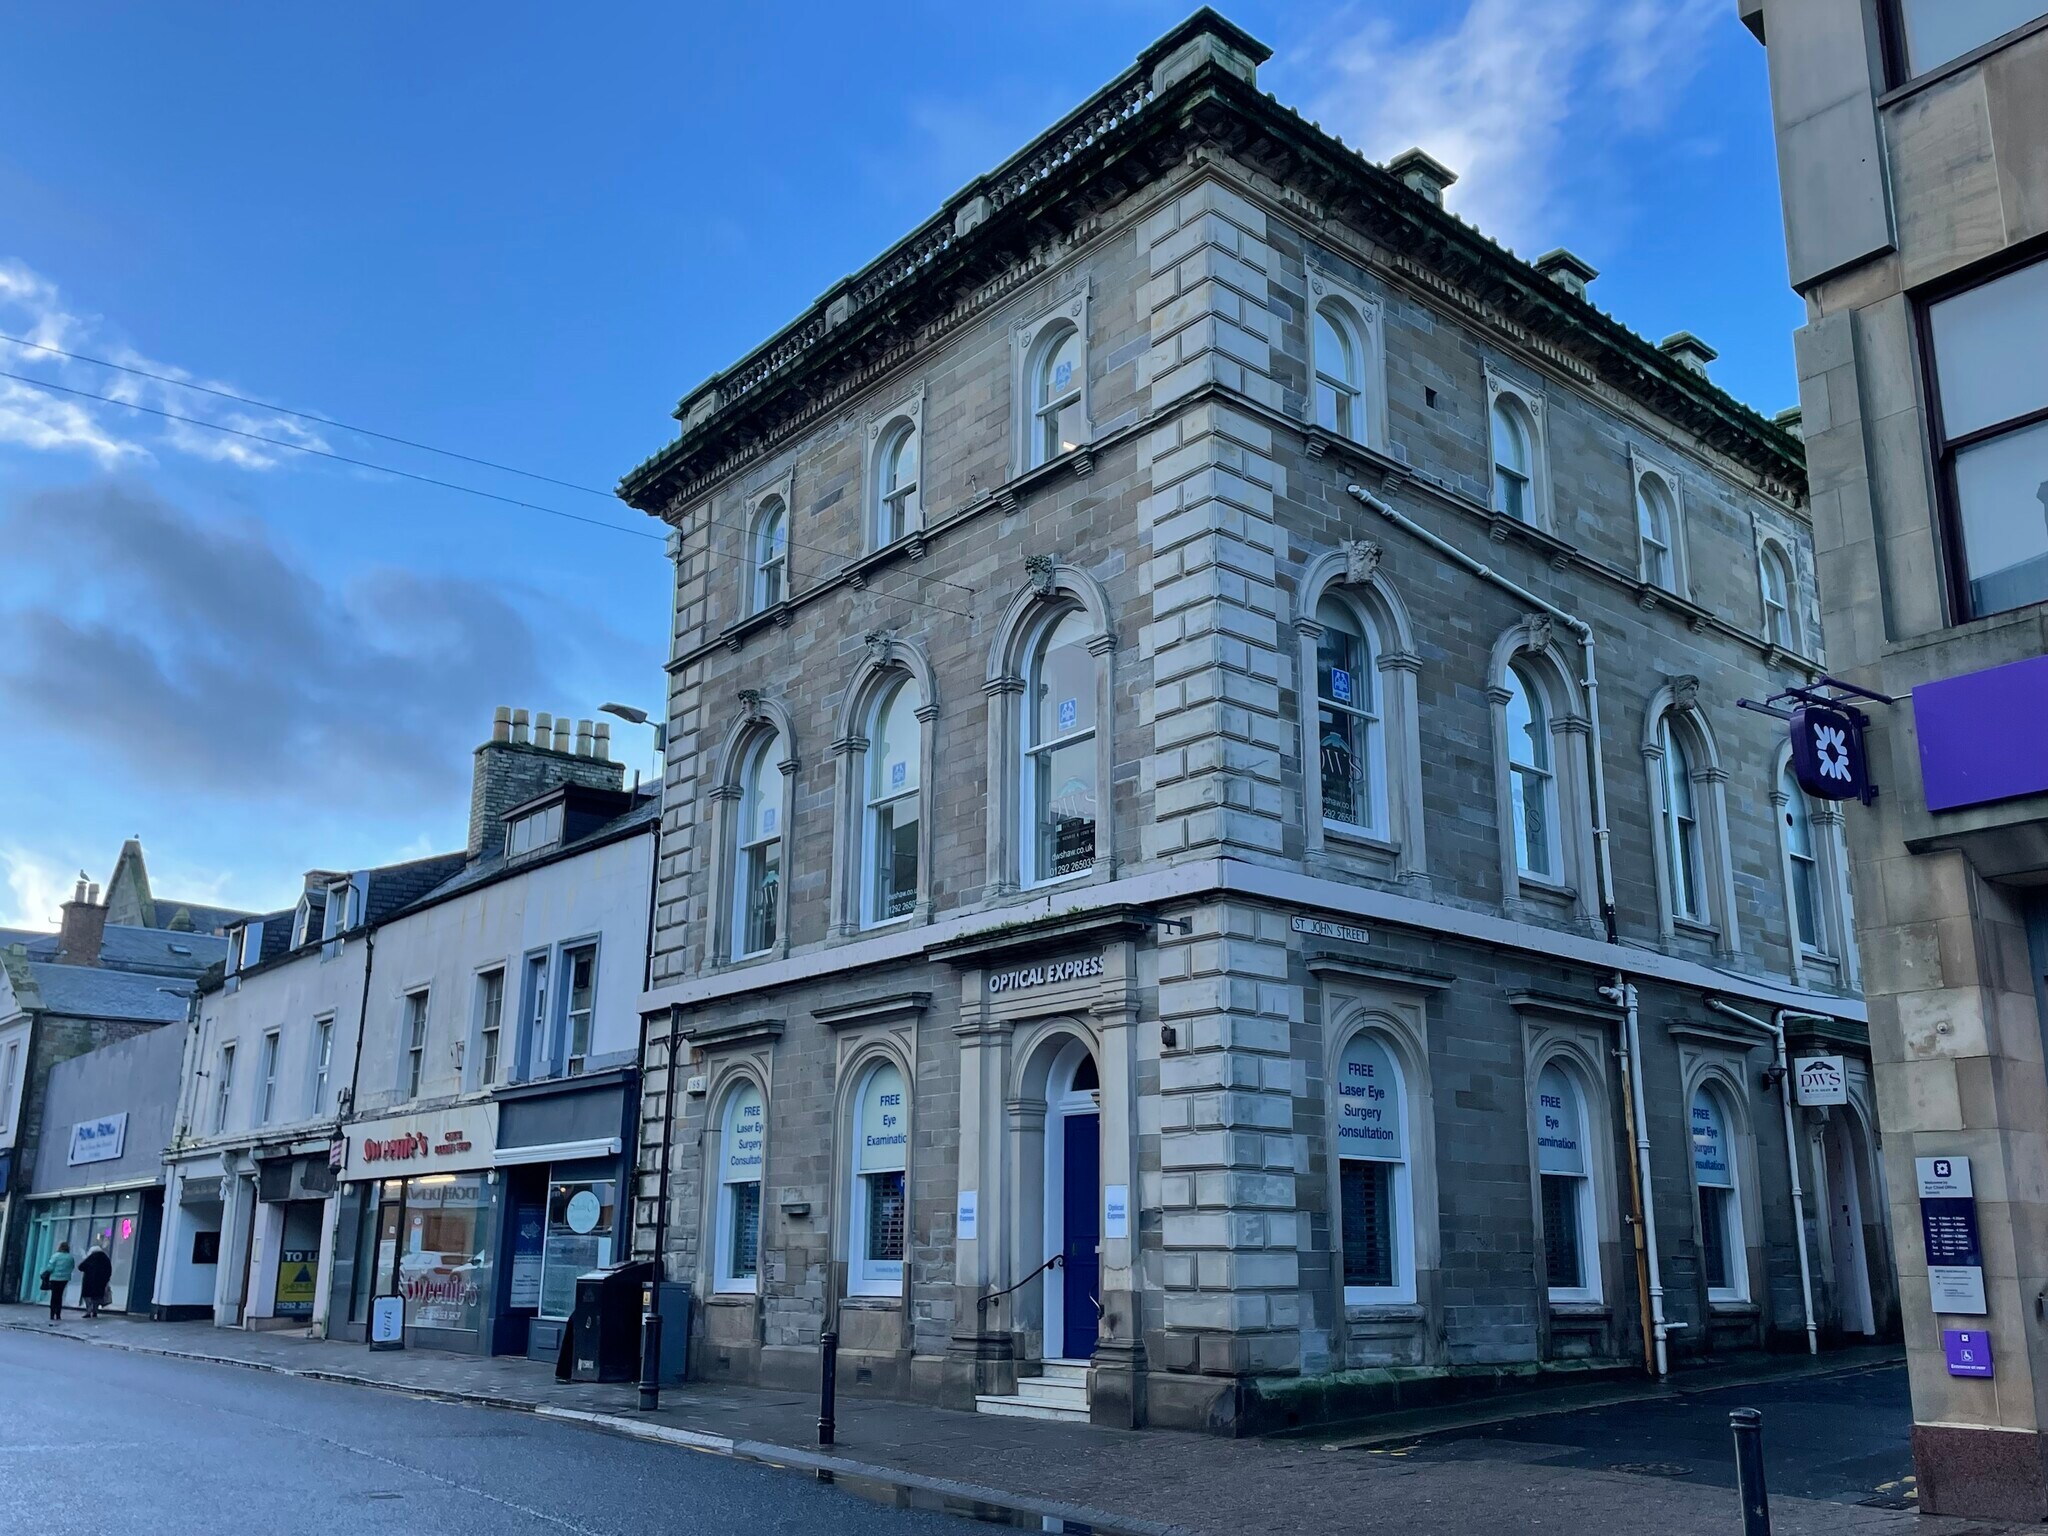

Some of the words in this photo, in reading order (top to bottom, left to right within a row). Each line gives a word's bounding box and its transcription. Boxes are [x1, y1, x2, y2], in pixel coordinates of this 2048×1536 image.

[1051, 843, 1094, 862] dwshaw.co.uk
[1050, 863, 1070, 877] 01292
[1295, 918, 1305, 930] ST
[1310, 920, 1333, 935] JOHN
[1337, 925, 1366, 941] STREET
[988, 966, 1044, 992] OPTICAL
[1047, 955, 1104, 982] EXPRESS
[1348, 1062, 1374, 1078] FREE
[1800, 1072, 1841, 1087] DWS
[1338, 1082, 1366, 1097] Laser
[1368, 1084, 1385, 1101] Eye
[880, 1093, 900, 1107] FREE
[1540, 1094, 1561, 1109] FREE
[744, 1106, 760, 1117] FREE
[1344, 1103, 1382, 1122] Surgery
[1692, 1107, 1710, 1120] FREE
[883, 1114, 897, 1127] Eye
[1545, 1115, 1559, 1130] Eye
[736, 1123, 753, 1134] Laser
[1706, 1126, 1718, 1139] Eye
[1107, 1203, 1125, 1212] Optical
[1107, 1212, 1126, 1221] Express
[285, 1251, 303, 1262] TO
